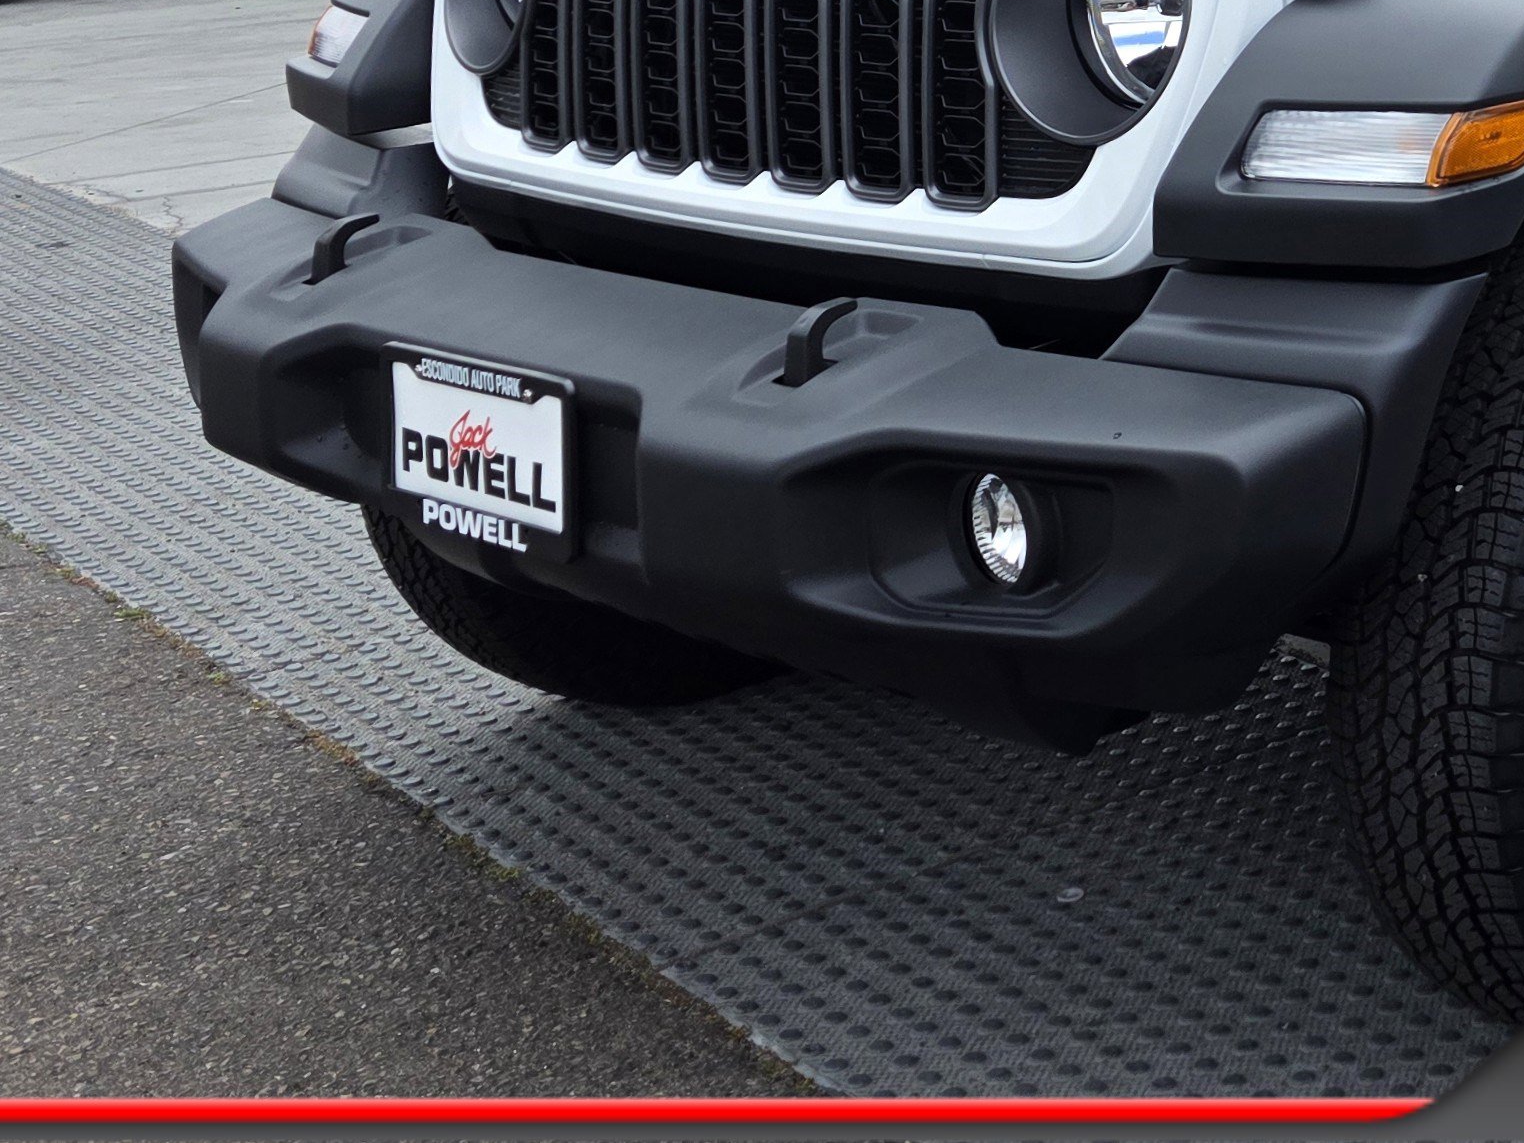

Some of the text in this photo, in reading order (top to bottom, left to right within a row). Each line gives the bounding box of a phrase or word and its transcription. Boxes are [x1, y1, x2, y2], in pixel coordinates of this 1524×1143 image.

[421, 358, 521, 398] ESCONDIDO AUTO PARK
[450, 409, 496, 469] Jack
[402, 426, 556, 513] POWELL
[422, 498, 527, 552] POWELL
